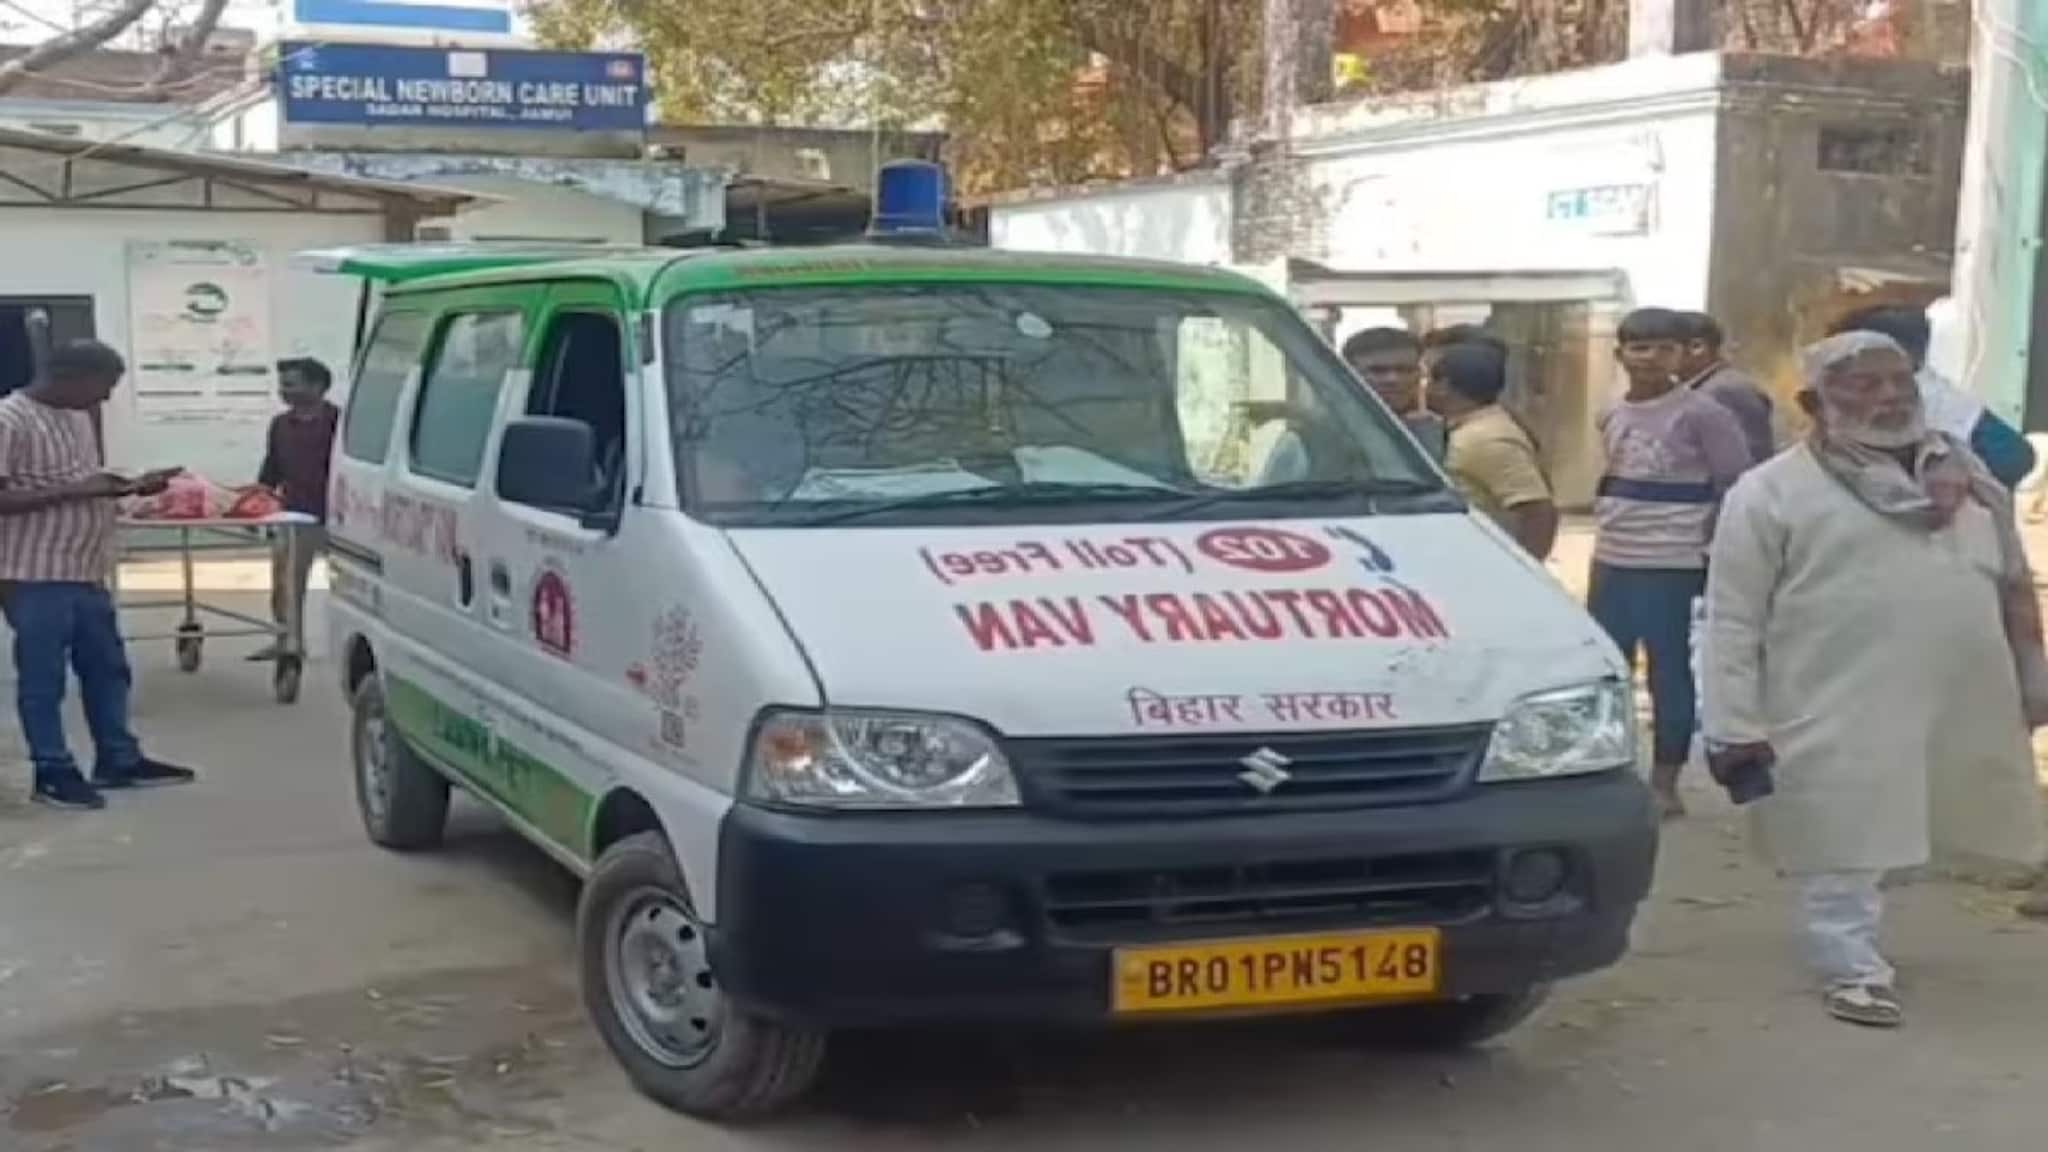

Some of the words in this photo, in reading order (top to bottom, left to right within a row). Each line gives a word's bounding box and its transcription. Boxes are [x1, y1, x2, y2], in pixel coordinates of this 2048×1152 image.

[289, 74, 392, 102] SPECIAL
[397, 78, 513, 104] NEWBORN
[517, 82, 580, 105] CARE
[584, 84, 638, 106] UNIT
[1127, 686, 1244, 726] बिहार
[1259, 691, 1398, 722] सरकार
[1148, 942, 1429, 998] BR01PN5148
